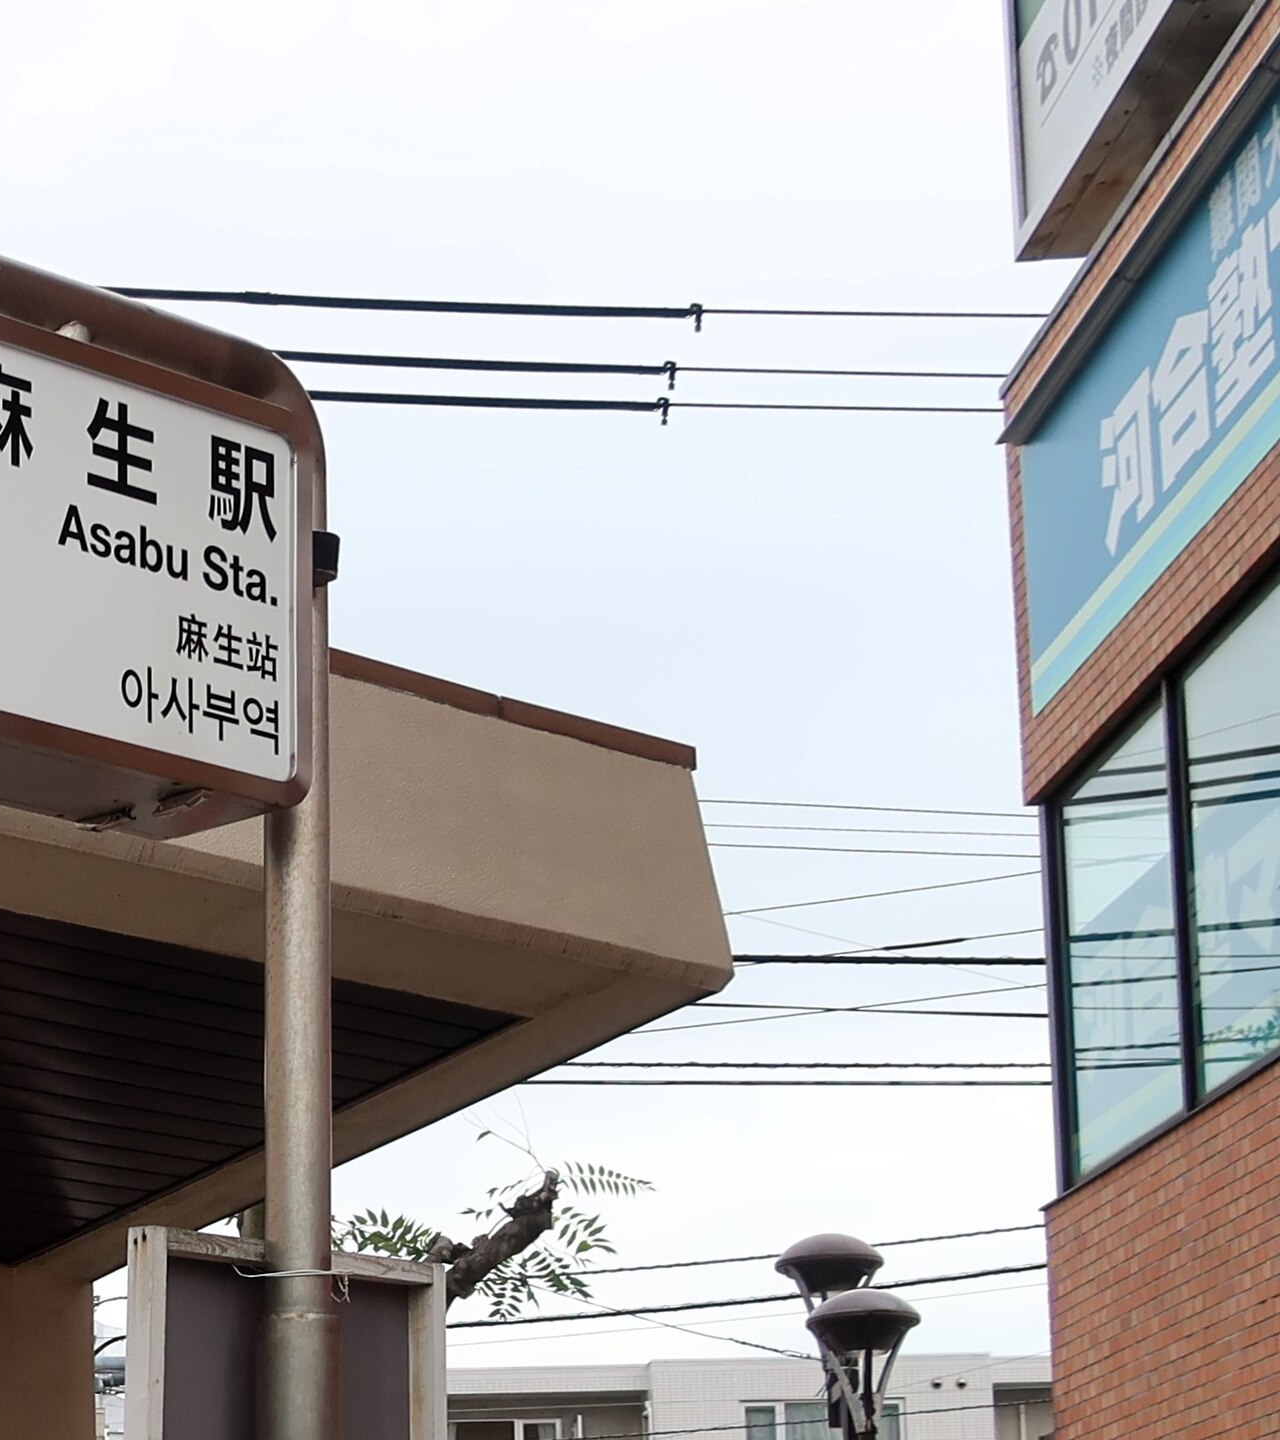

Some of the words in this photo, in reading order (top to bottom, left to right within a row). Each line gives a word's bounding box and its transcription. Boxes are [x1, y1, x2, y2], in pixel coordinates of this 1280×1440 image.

[1099, 199, 1280, 557] 河合塾
[57, 504, 189, 581] Asabu
[202, 545, 278, 607] Sta.
[176, 613, 278, 682] 麻生站
[121, 666, 279, 756] 아사부역
